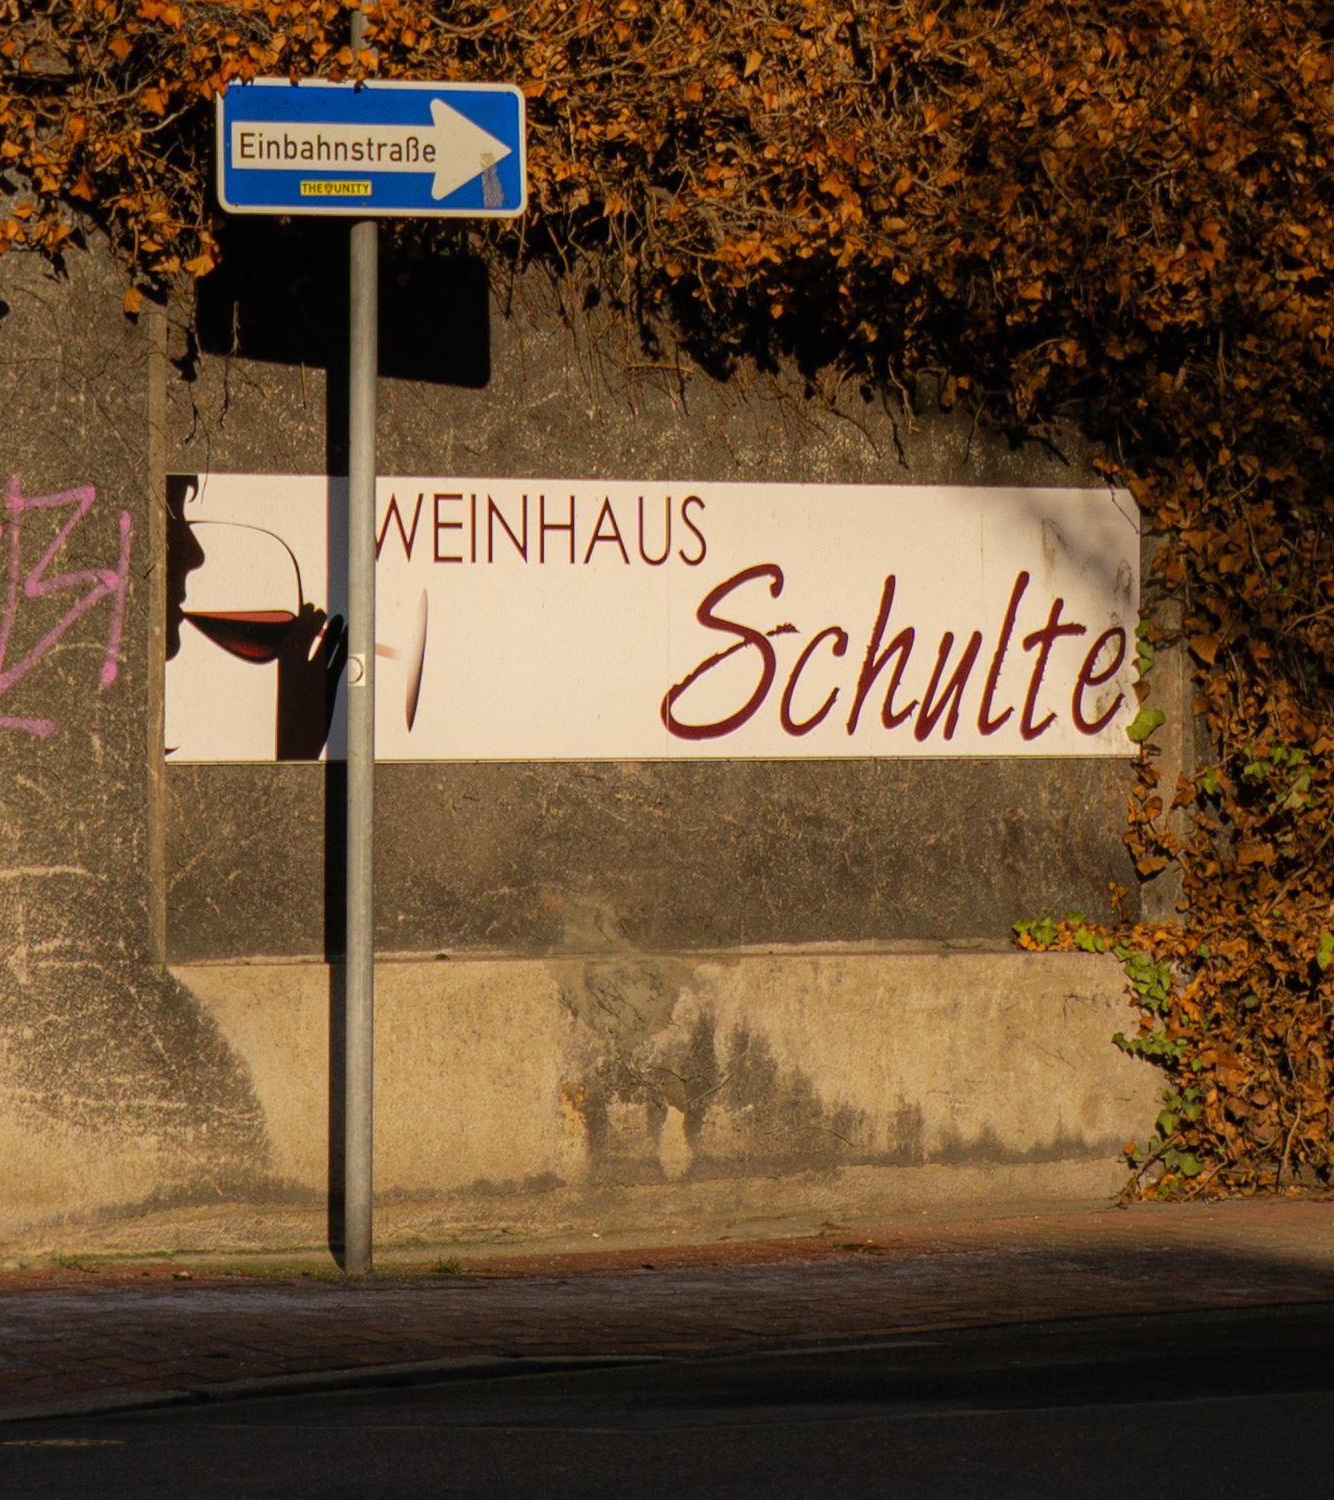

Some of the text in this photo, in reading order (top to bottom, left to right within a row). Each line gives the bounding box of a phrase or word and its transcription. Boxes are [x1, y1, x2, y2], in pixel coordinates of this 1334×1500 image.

[240, 132, 436, 163] Einbahnstraße
[303, 183, 369, 194] THE UNITY
[660, 562, 1126, 742] Schulte
